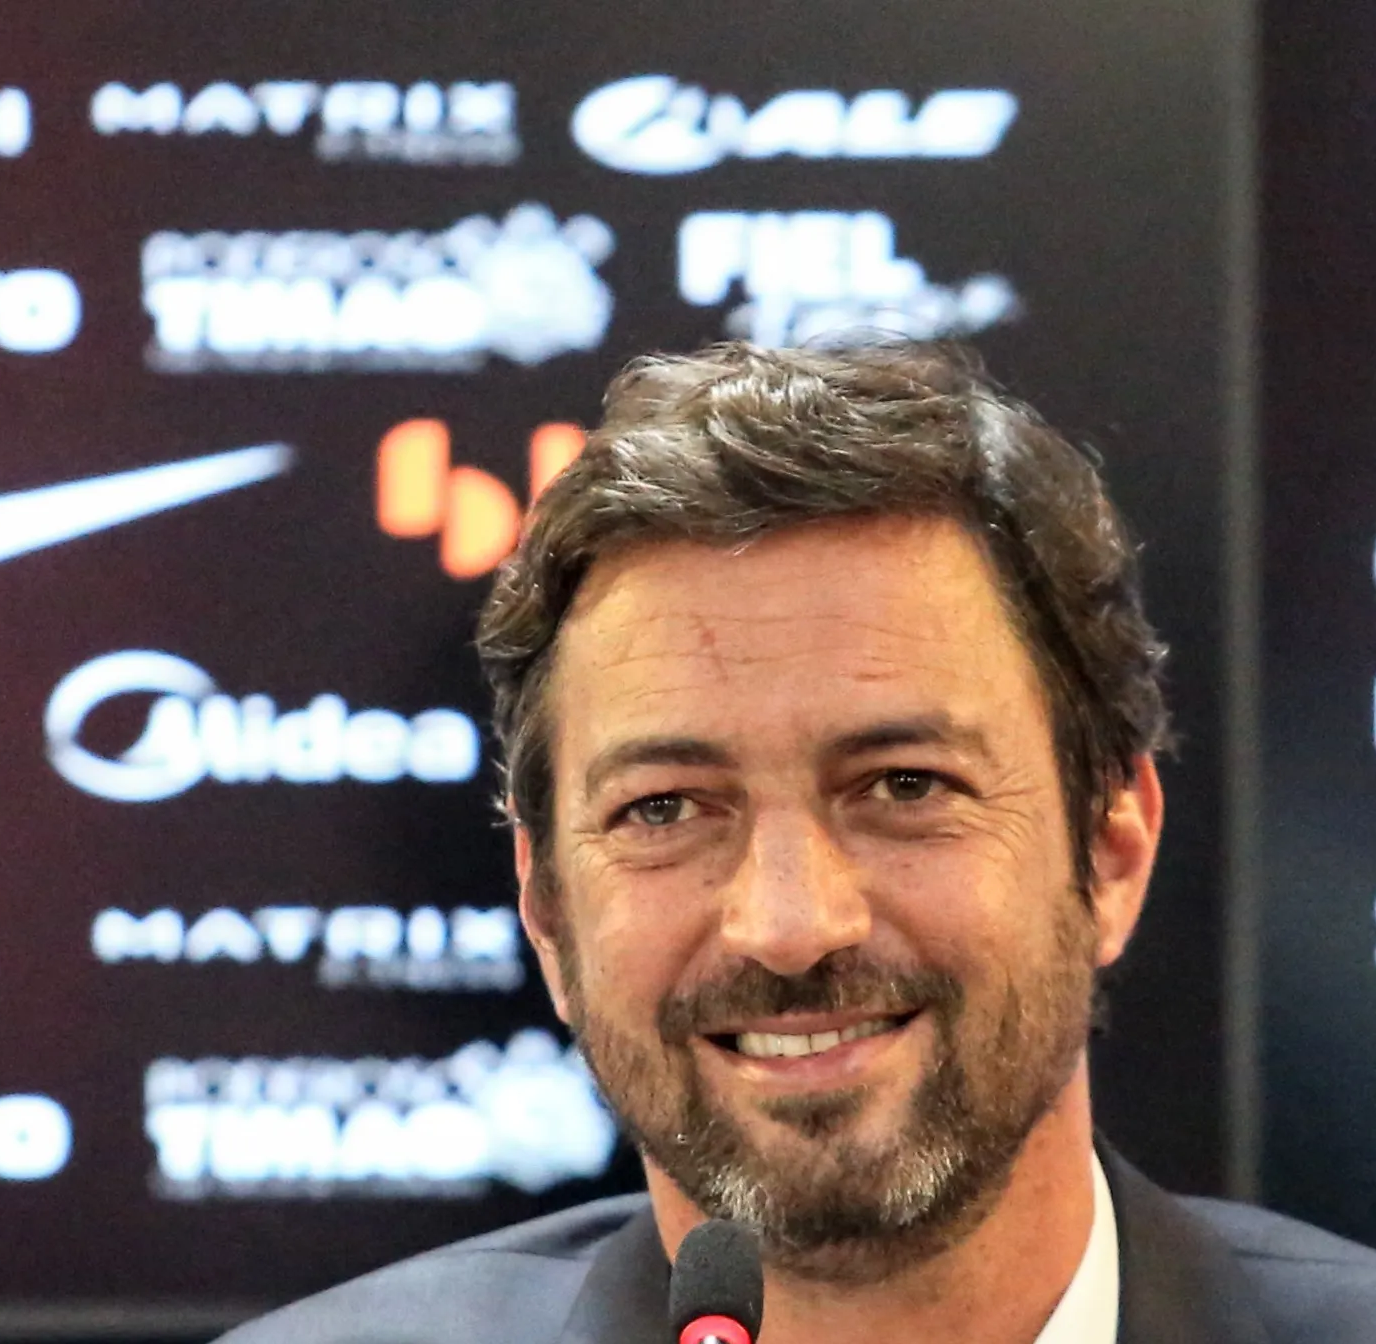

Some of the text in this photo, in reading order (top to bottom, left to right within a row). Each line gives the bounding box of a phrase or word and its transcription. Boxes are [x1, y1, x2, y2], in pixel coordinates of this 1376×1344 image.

[88, 83, 515, 135] MATRIX
[125, 690, 481, 784] Midea
[91, 906, 518, 962] MATRIX
